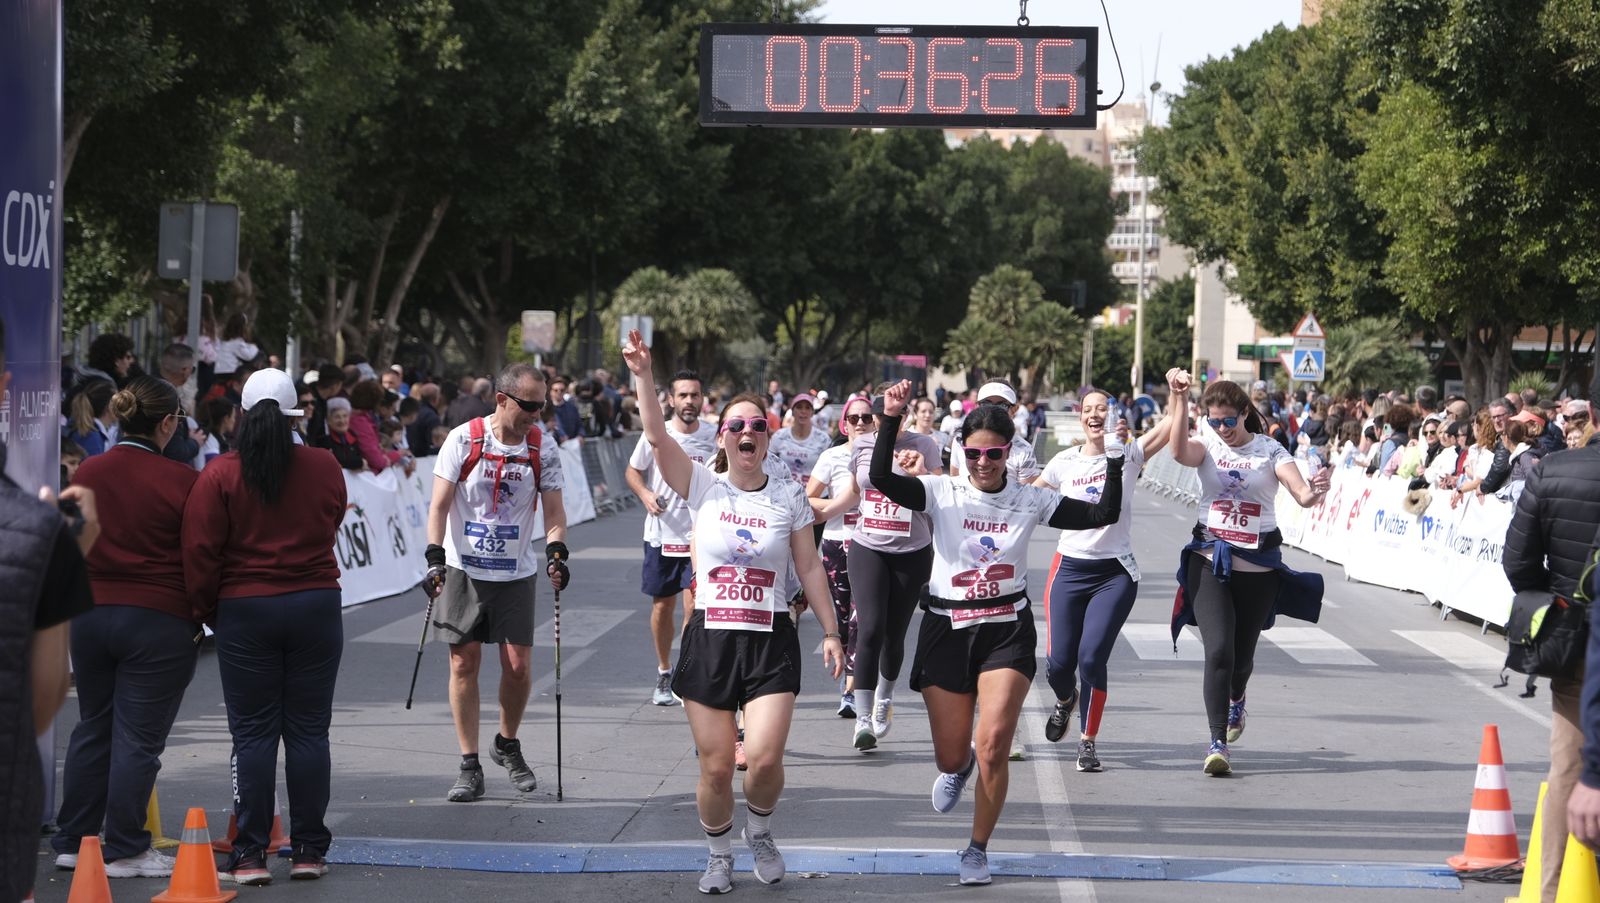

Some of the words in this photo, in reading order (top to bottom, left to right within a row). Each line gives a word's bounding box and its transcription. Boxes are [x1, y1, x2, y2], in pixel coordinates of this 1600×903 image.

[765, 35, 1077, 116] 00:36:26
[3, 180, 55, 269] CDX
[1216, 458, 1252, 470] MUJER
[484, 469, 523, 481] MJER
[874, 502, 900, 516] 517
[720, 511, 767, 529] MUJER
[963, 518, 1009, 533] MUJER
[1221, 511, 1249, 528] 716
[335, 520, 373, 571] CASI
[474, 537, 506, 553] 432
[715, 583, 764, 603] 2600
